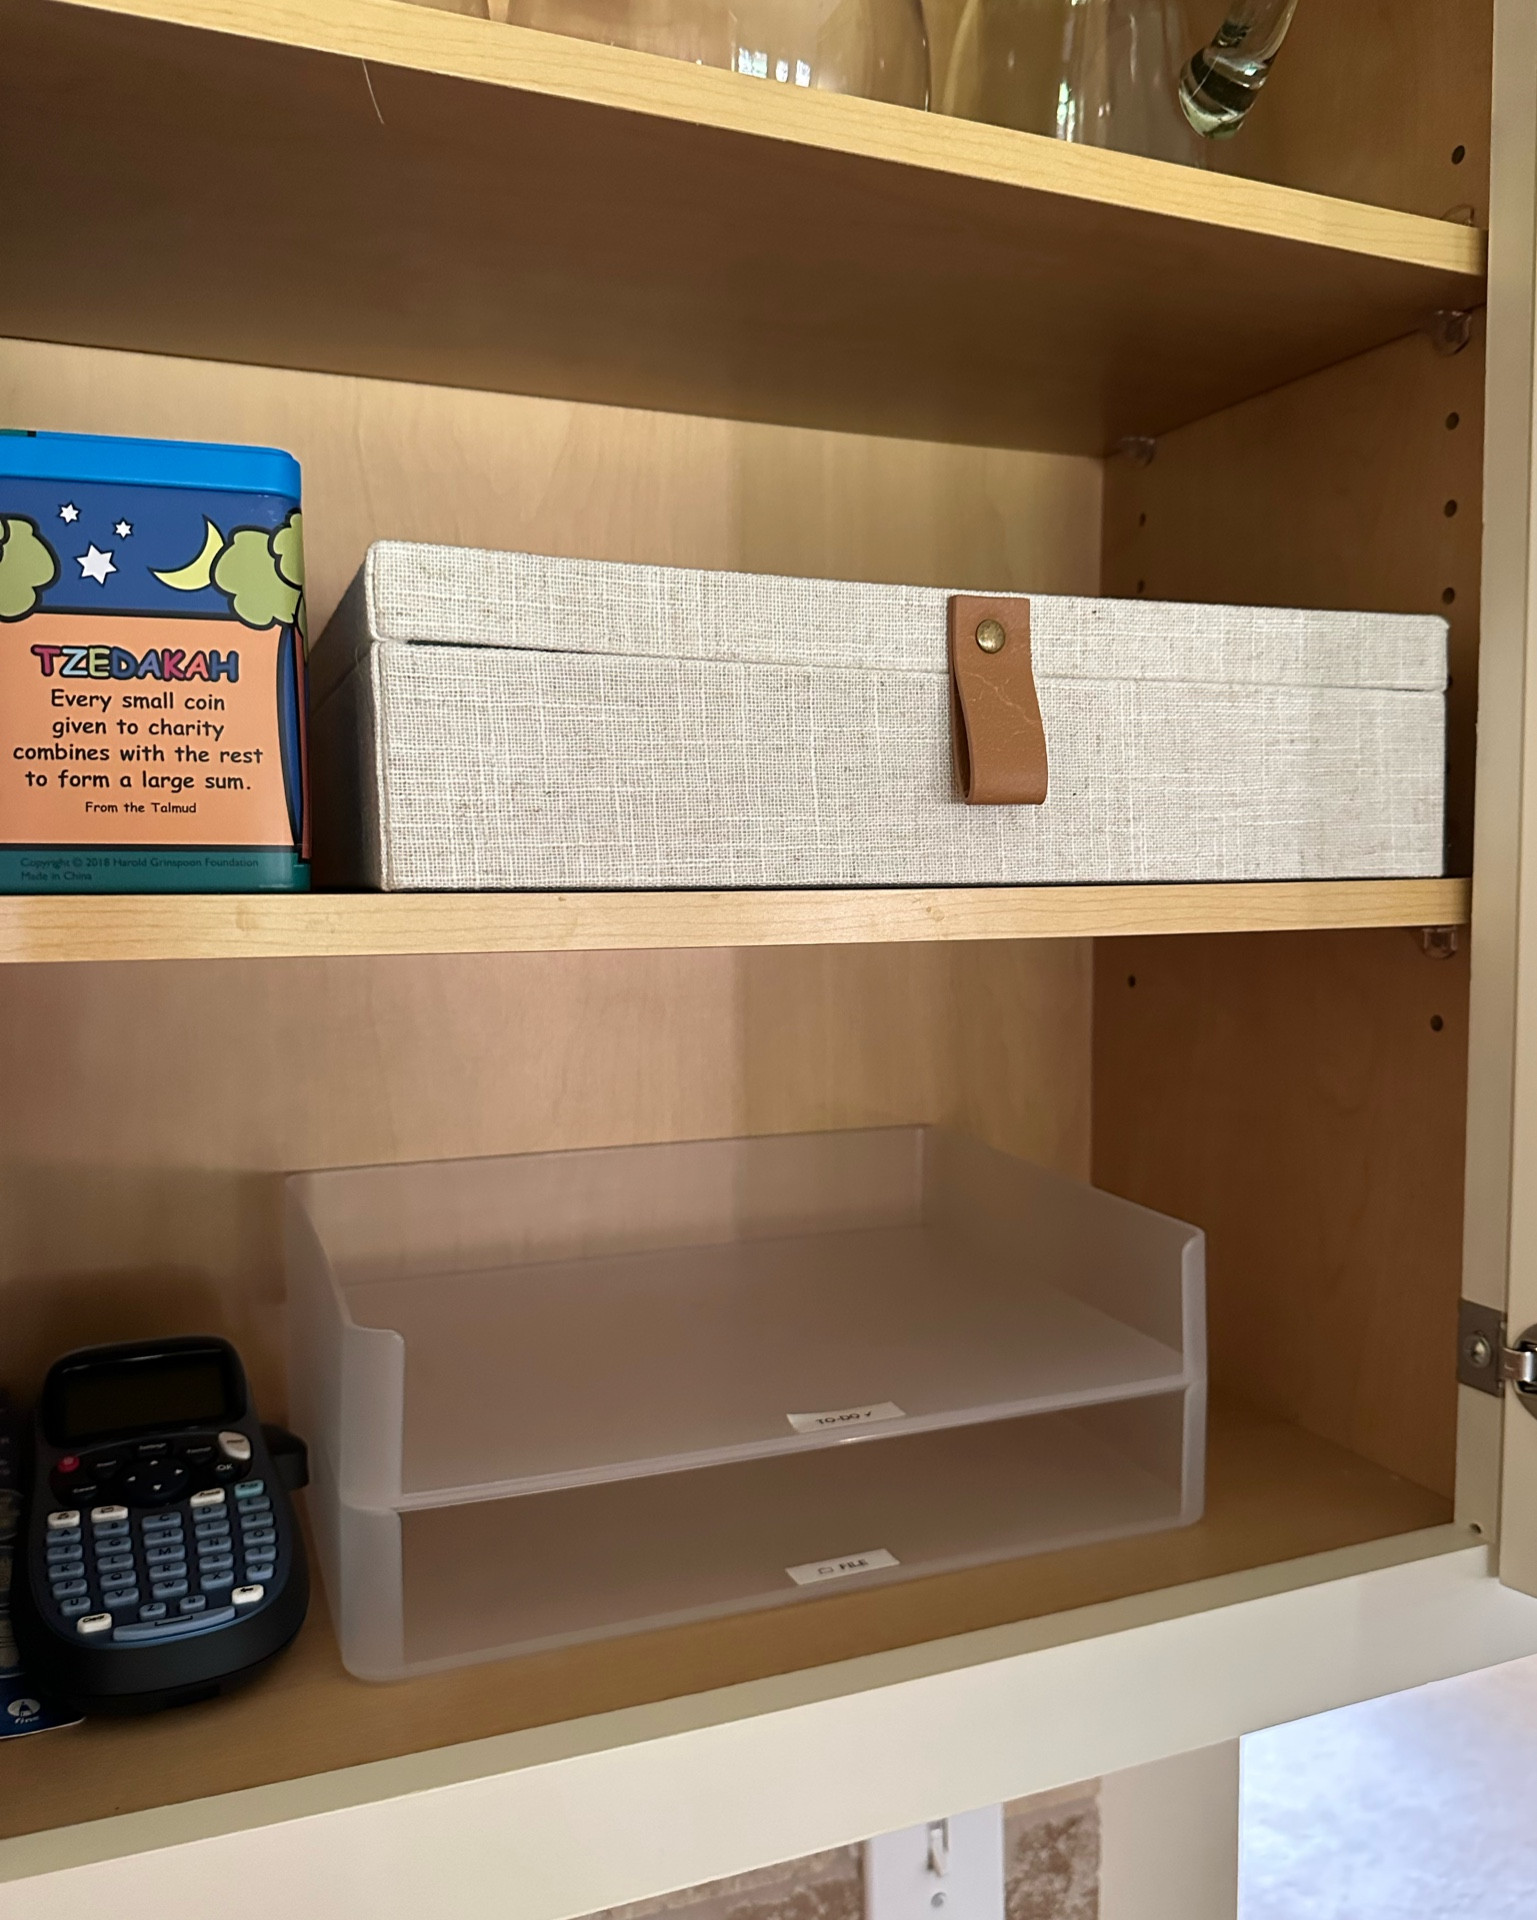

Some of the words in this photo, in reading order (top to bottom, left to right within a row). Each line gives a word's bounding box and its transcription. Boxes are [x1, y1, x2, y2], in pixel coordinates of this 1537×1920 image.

[30, 644, 240, 682] TZEDAKAH
[51, 689, 112, 712] Every
[122, 692, 174, 710] small
[184, 694, 225, 710] coin
[52, 718, 106, 738] given
[117, 720, 138, 734] to
[148, 719, 224, 740] charity
[13, 744, 110, 760] combines
[120, 745, 164, 762] with
[174, 746, 209, 762] the
[220, 748, 263, 764] rest
[25, 771, 47, 787] to
[58, 770, 110, 788] form
[120, 776, 132, 788] a
[142, 771, 194, 792] large
[205, 776, 251, 790] sum.
[85, 802, 118, 813] From
[124, 802, 145, 813] the
[151, 802, 196, 814] Talmud
[20, 858, 69, 869] Copyright
[86, 858, 110, 867] 2018
[113, 858, 147, 867] Harold
[150, 858, 201, 870] Grinspoon
[205, 858, 258, 868] Foundation
[21, 871, 48, 881] Made
[51, 872, 60, 880] in
[64, 871, 92, 881] China
[815, 1412, 861, 1425] TO-DO
[215, 1463, 233, 1471] OK
[159, 1547, 171, 1555] M
[839, 1558, 869, 1571] FILE
